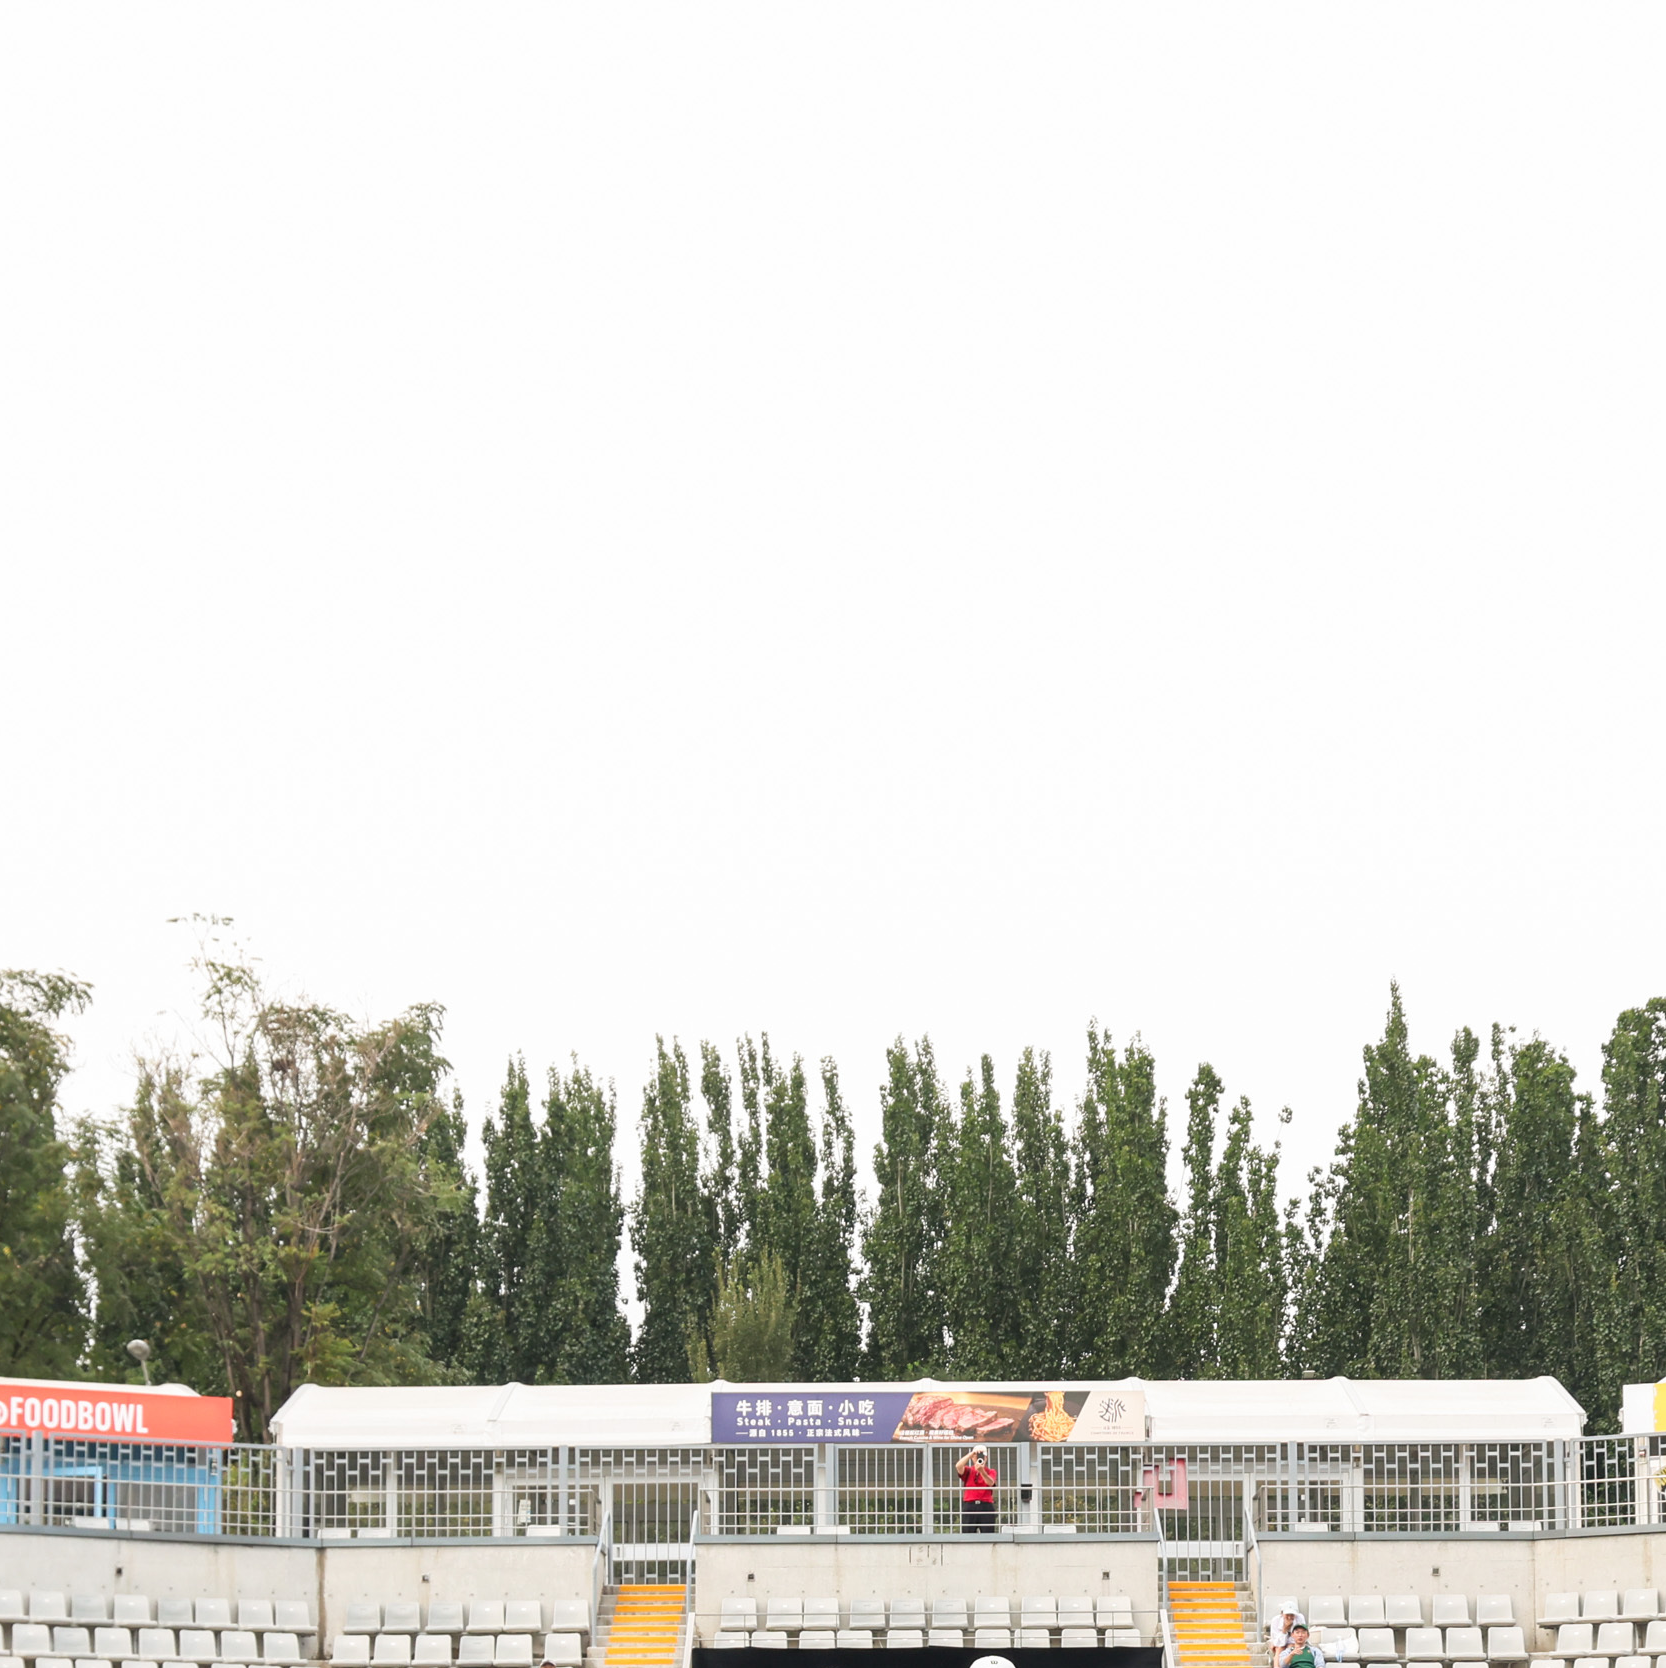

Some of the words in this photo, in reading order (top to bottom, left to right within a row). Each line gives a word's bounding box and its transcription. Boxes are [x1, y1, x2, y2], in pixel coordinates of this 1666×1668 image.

[736, 1417, 771, 1426] Steak
[787, 1417, 822, 1426] Pasta
[838, 1417, 874, 1426] Snack
